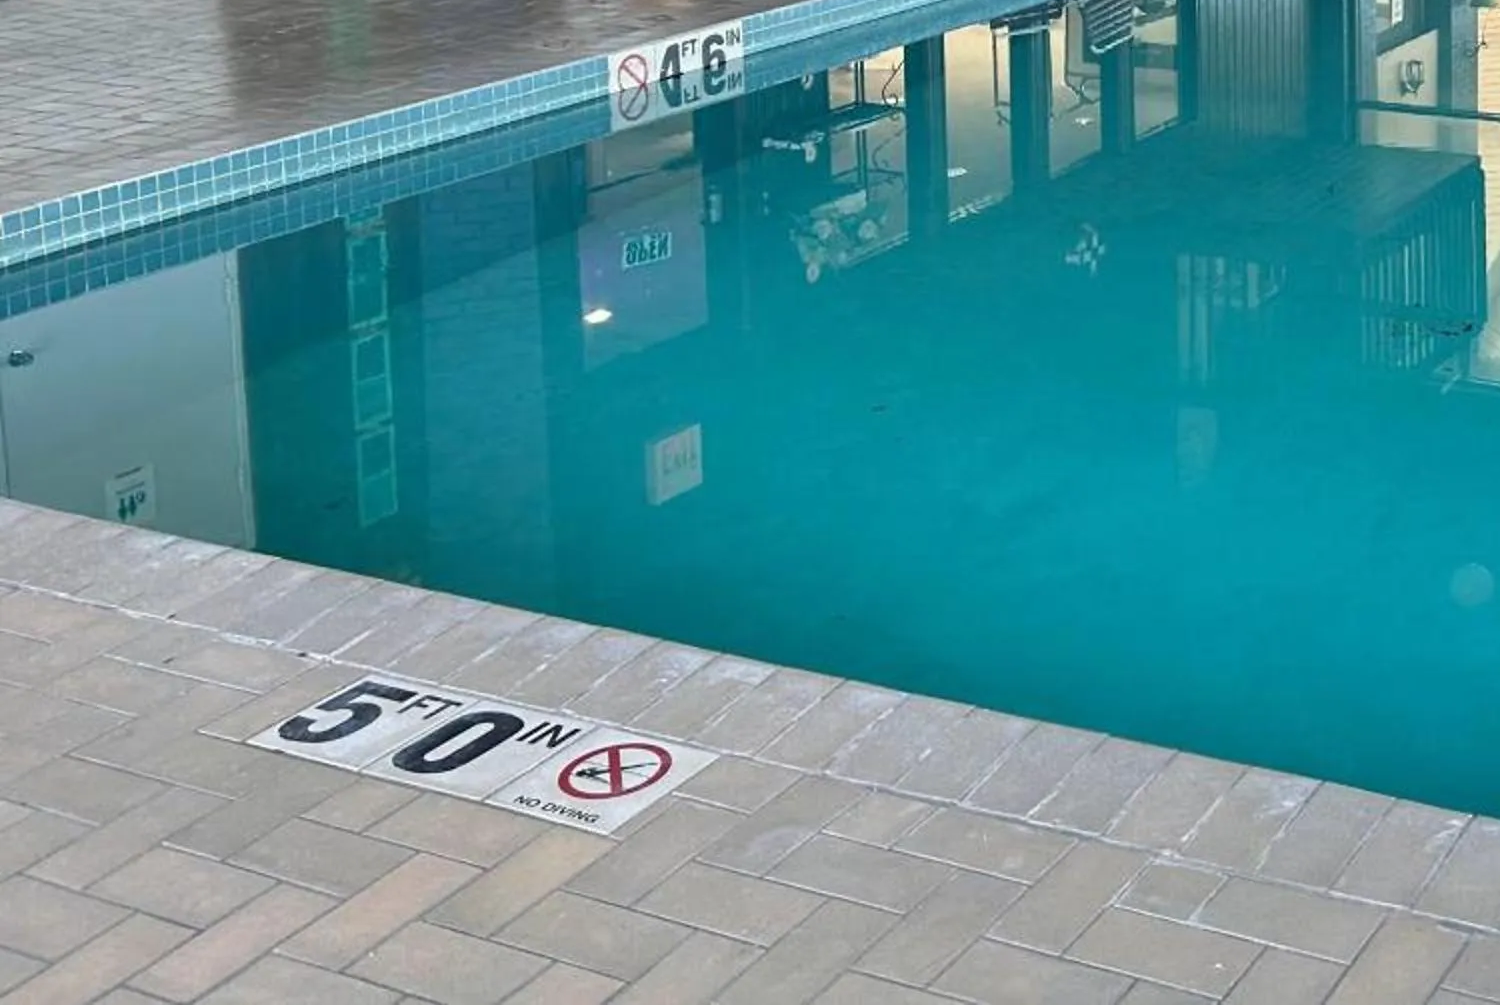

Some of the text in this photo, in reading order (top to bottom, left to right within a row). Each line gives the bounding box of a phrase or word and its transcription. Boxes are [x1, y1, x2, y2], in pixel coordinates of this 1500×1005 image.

[660, 27, 741, 81] 4 FT 6 IN
[278, 681, 581, 773] 5 FT 0 IN
[513, 795, 600, 823] NO DIVING
